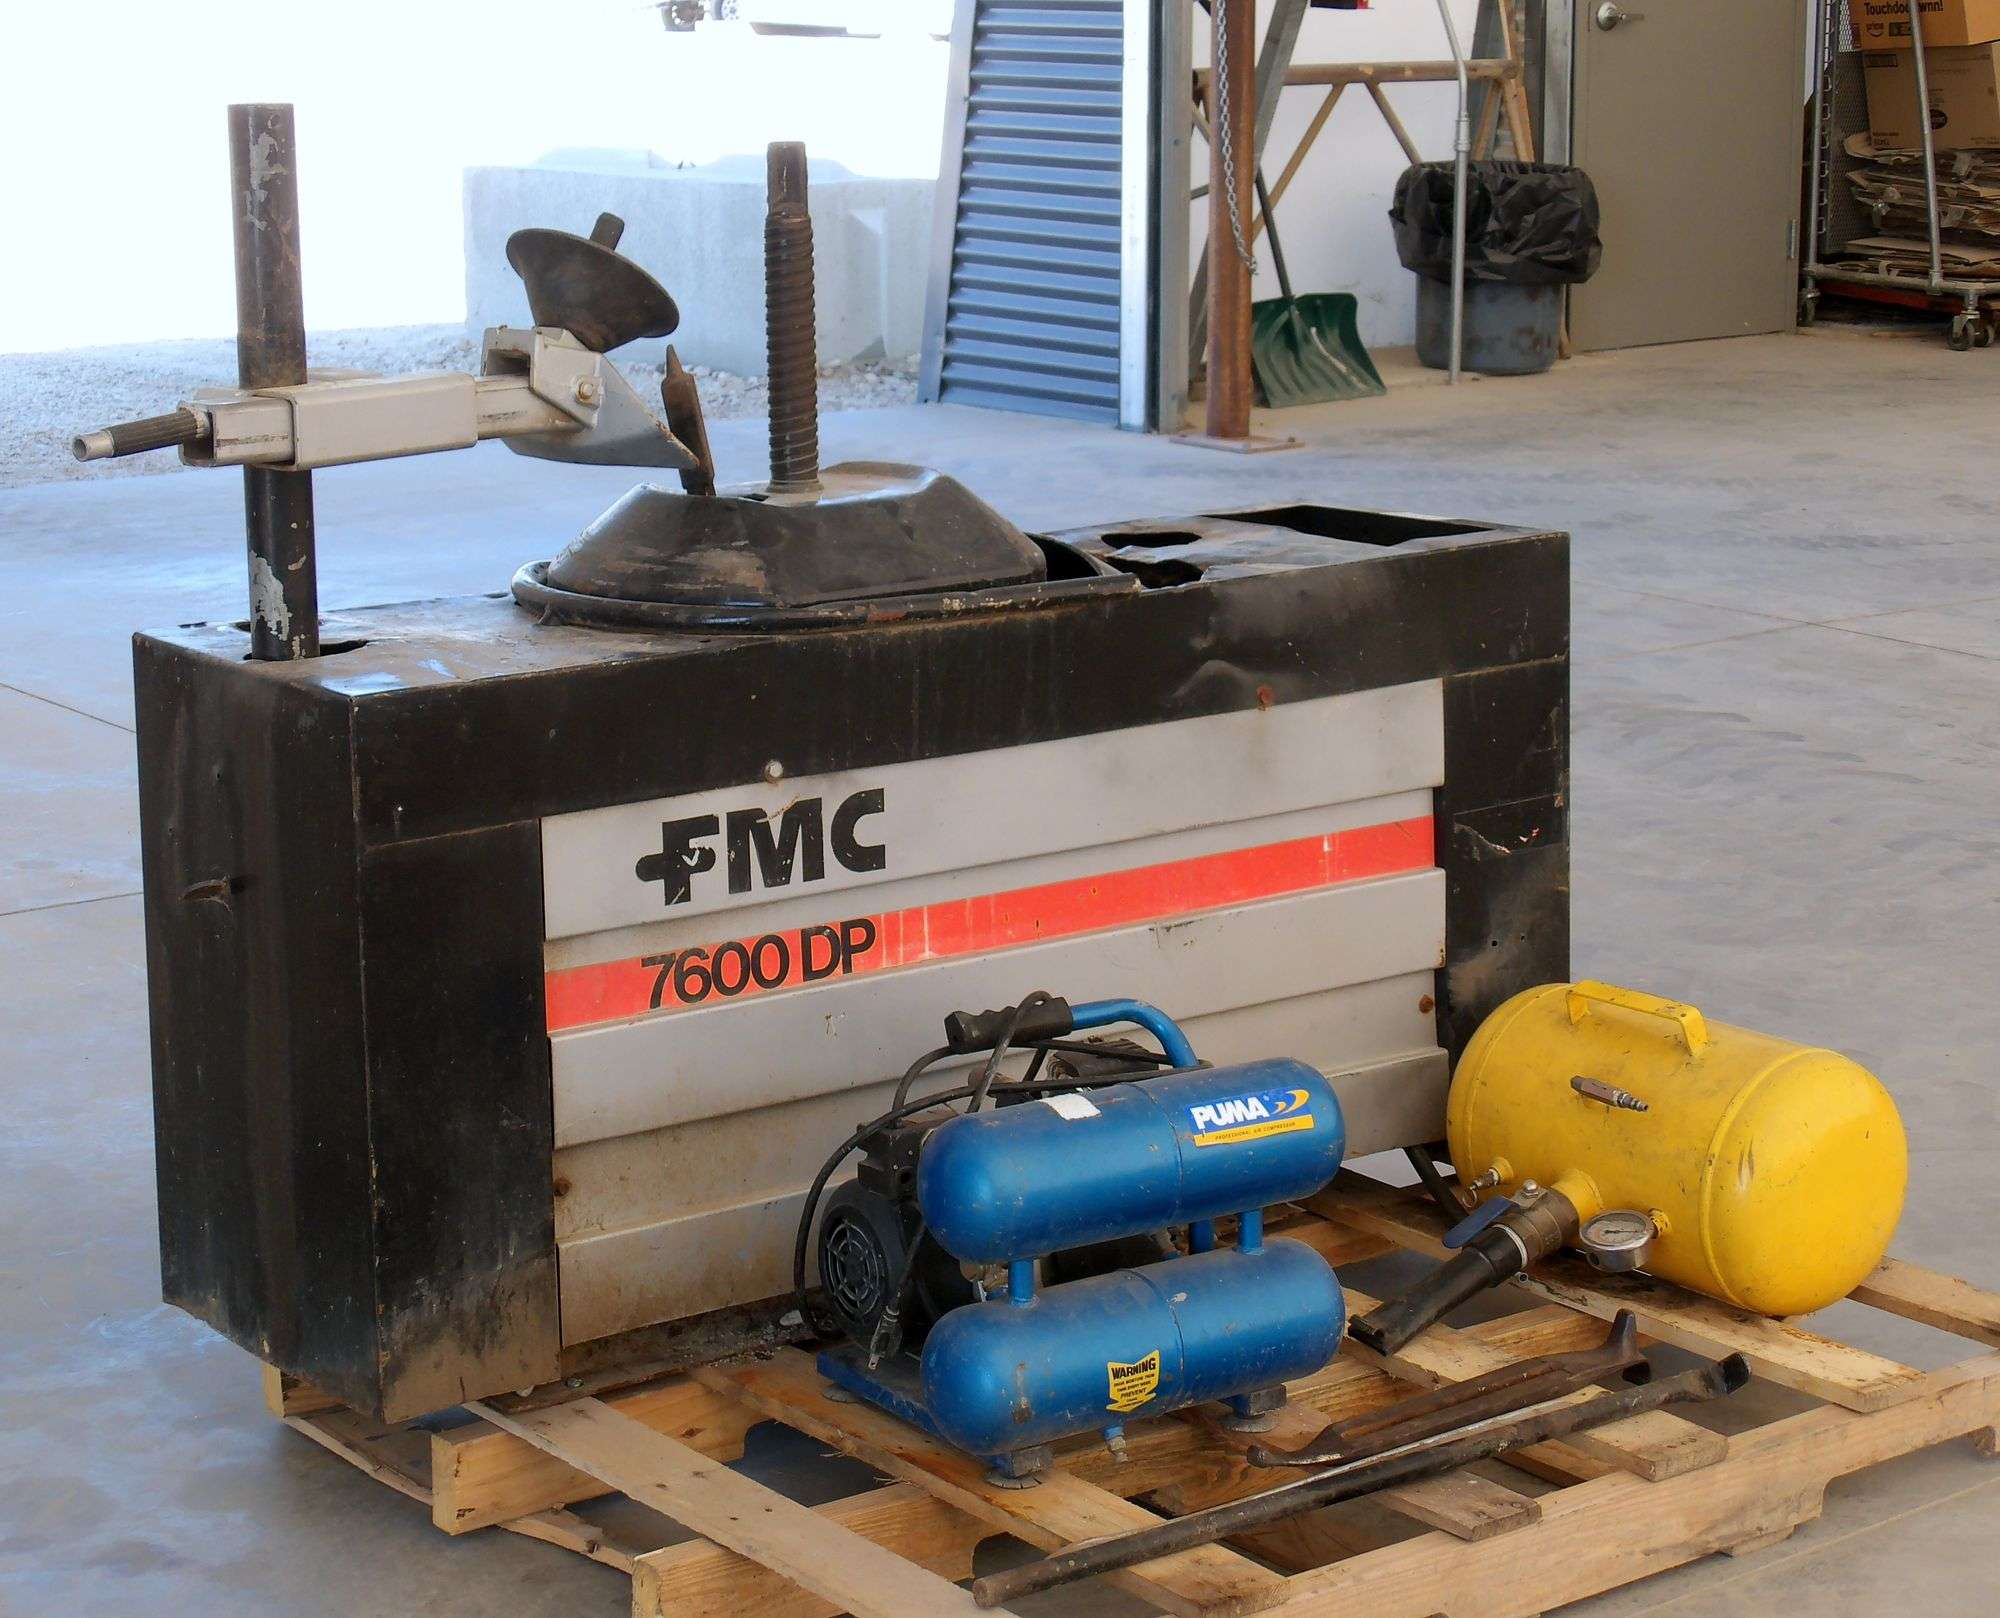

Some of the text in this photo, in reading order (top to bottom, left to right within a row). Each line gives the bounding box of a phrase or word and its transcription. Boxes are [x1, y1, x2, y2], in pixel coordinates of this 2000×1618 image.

[635, 787, 886, 906] FMC
[640, 917, 877, 1010] 7600 DP
[1190, 1096, 1270, 1130] PUMA
[1111, 1357, 1156, 1380] WARNING
[1120, 1387, 1148, 1399] PREVENT
